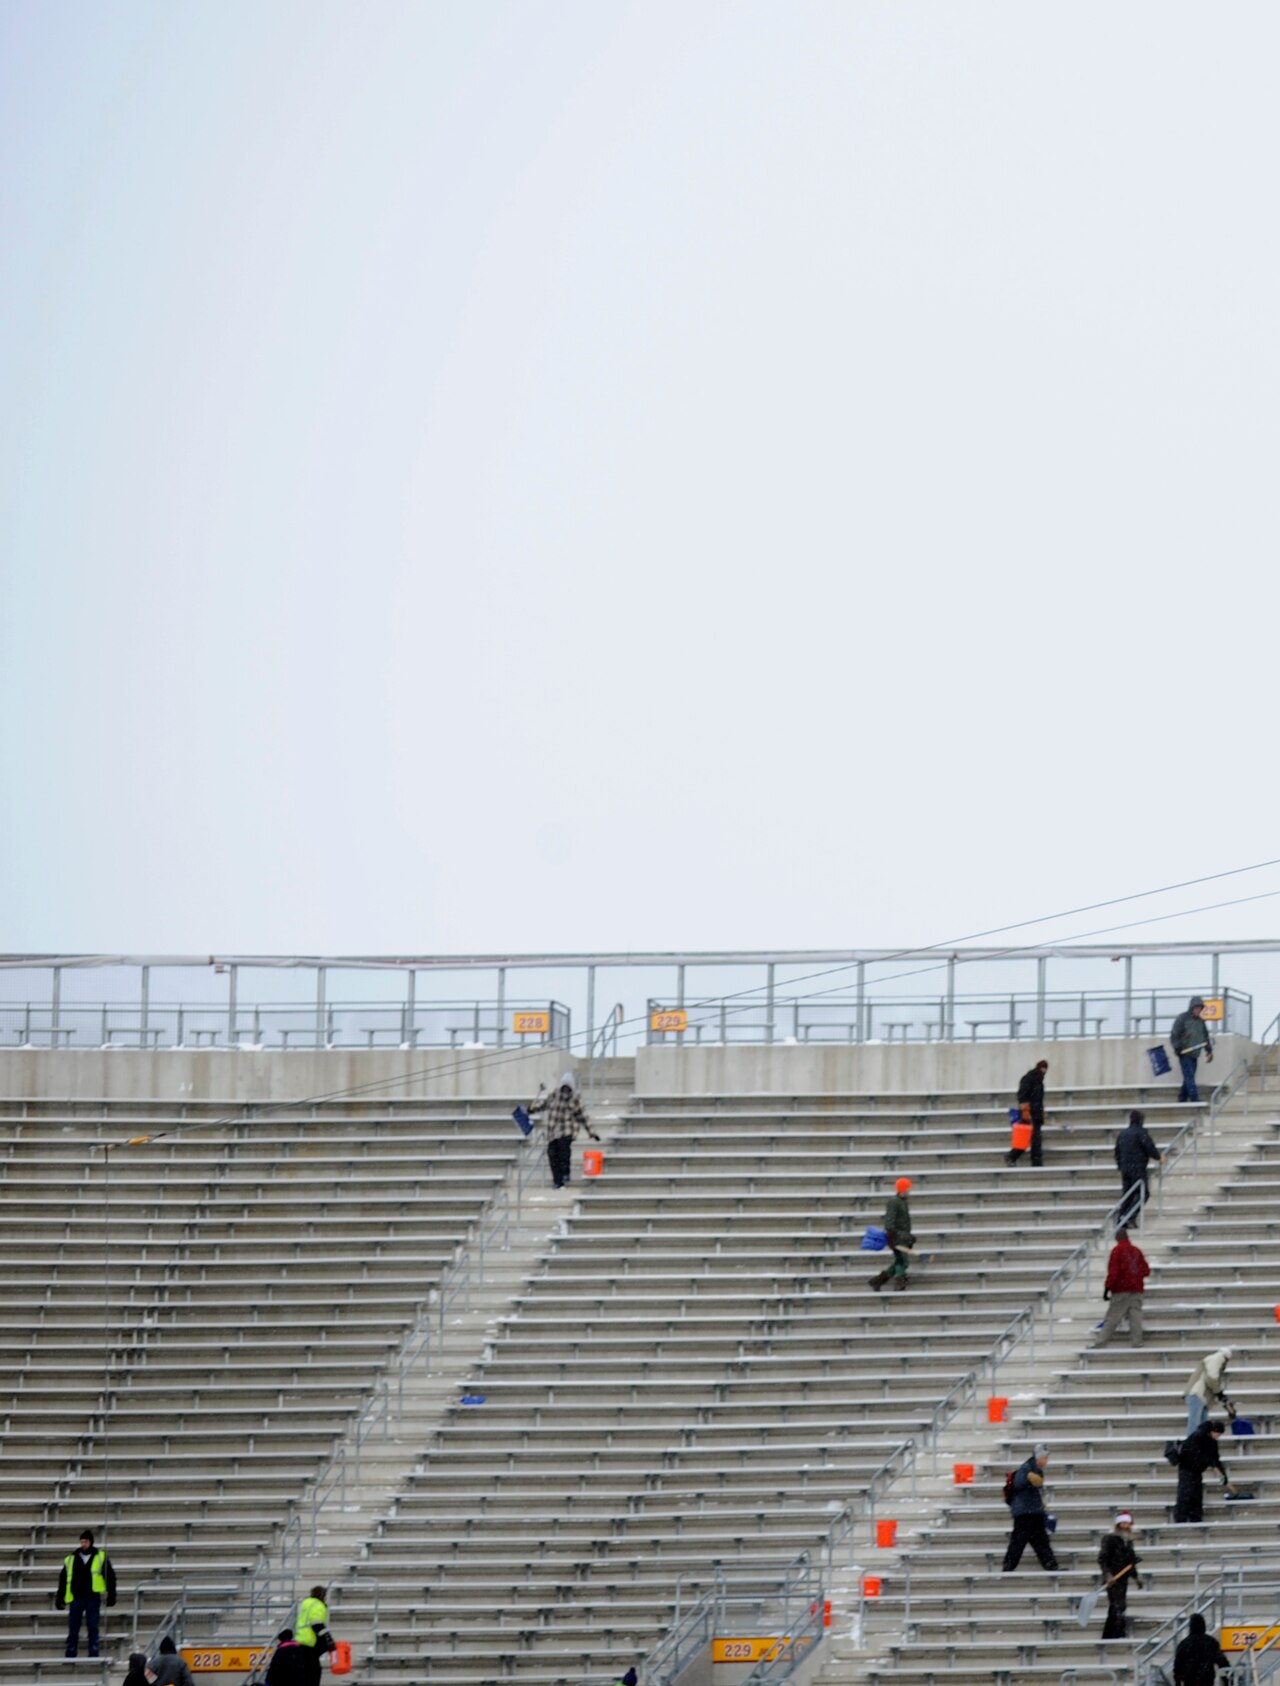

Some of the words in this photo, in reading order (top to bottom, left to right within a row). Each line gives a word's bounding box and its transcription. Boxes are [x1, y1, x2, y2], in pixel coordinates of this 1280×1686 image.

[519, 1017, 544, 1029] 228
[656, 1013, 681, 1027] 229
[724, 1644, 751, 1657] 229
[193, 1654, 221, 1667] 228
